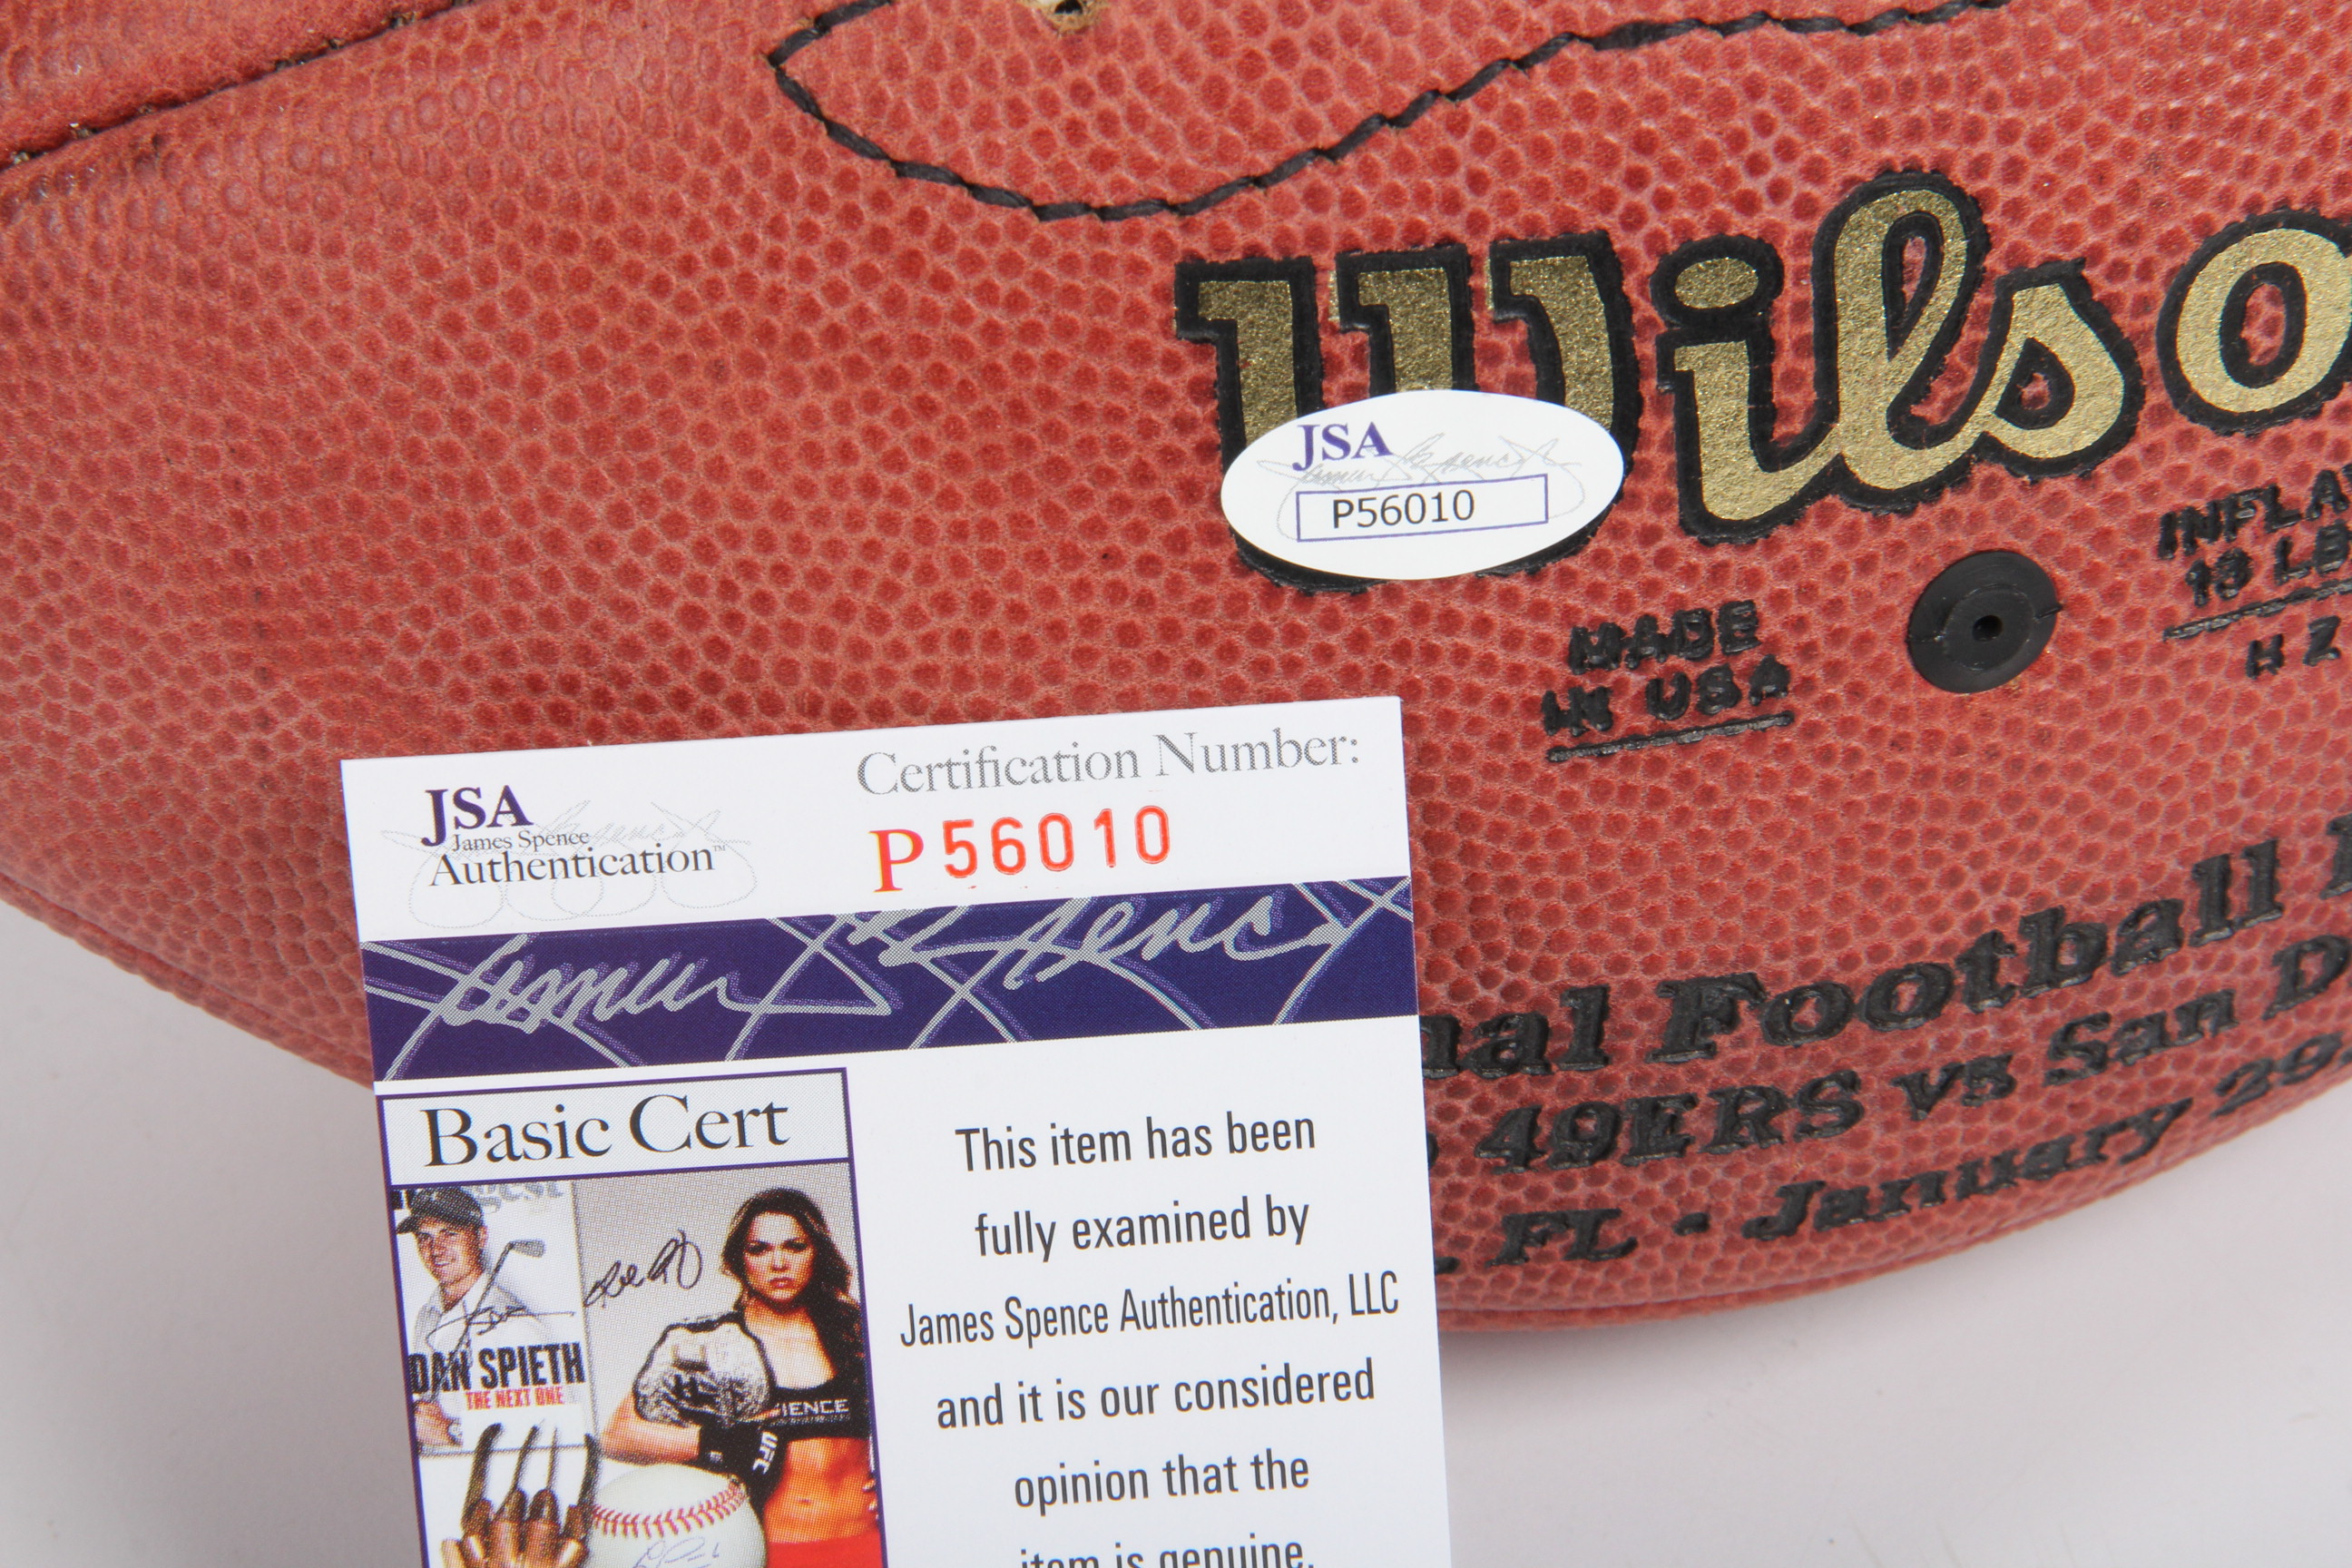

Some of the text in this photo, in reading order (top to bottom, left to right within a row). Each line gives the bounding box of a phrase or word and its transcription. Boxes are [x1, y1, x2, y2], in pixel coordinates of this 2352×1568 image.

[1292, 421, 1395, 472] JSA
[1332, 489, 1475, 529] P56010
[2157, 464, 2352, 560] INFLA
[2274, 519, 2352, 585] LB
[1569, 600, 1762, 675] MADE
[1542, 654, 1790, 736] IN USA
[856, 727, 1360, 796] Certification Number:
[421, 785, 534, 847] JSA
[453, 829, 590, 852] James Spence
[868, 805, 1171, 893] P56010
[1645, 839, 2283, 1064] Football
[1474, 1069, 1865, 1174] 49ERS
[1890, 1054, 2017, 1121] vs
[2043, 988, 2239, 1086] San
[419, 1093, 789, 1167] Basic Cert
[955, 1111, 1316, 1171] This item has been
[1485, 1208, 1639, 1268] FL
[1740, 1097, 2194, 1240] January
[975, 1194, 1309, 1263] fully examined by
[900, 1270, 1400, 1348] James Spence Authentication, LLC
[465, 1387, 564, 1411] THE NEXT ONE
[478, 1340, 586, 1390] SPIETH
[937, 1357, 1376, 1428] and it is our considered
[775, 1398, 849, 1417] IENCE
[752, 1431, 779, 1475] UFC
[1014, 1448, 1309, 1516] opinion that the
